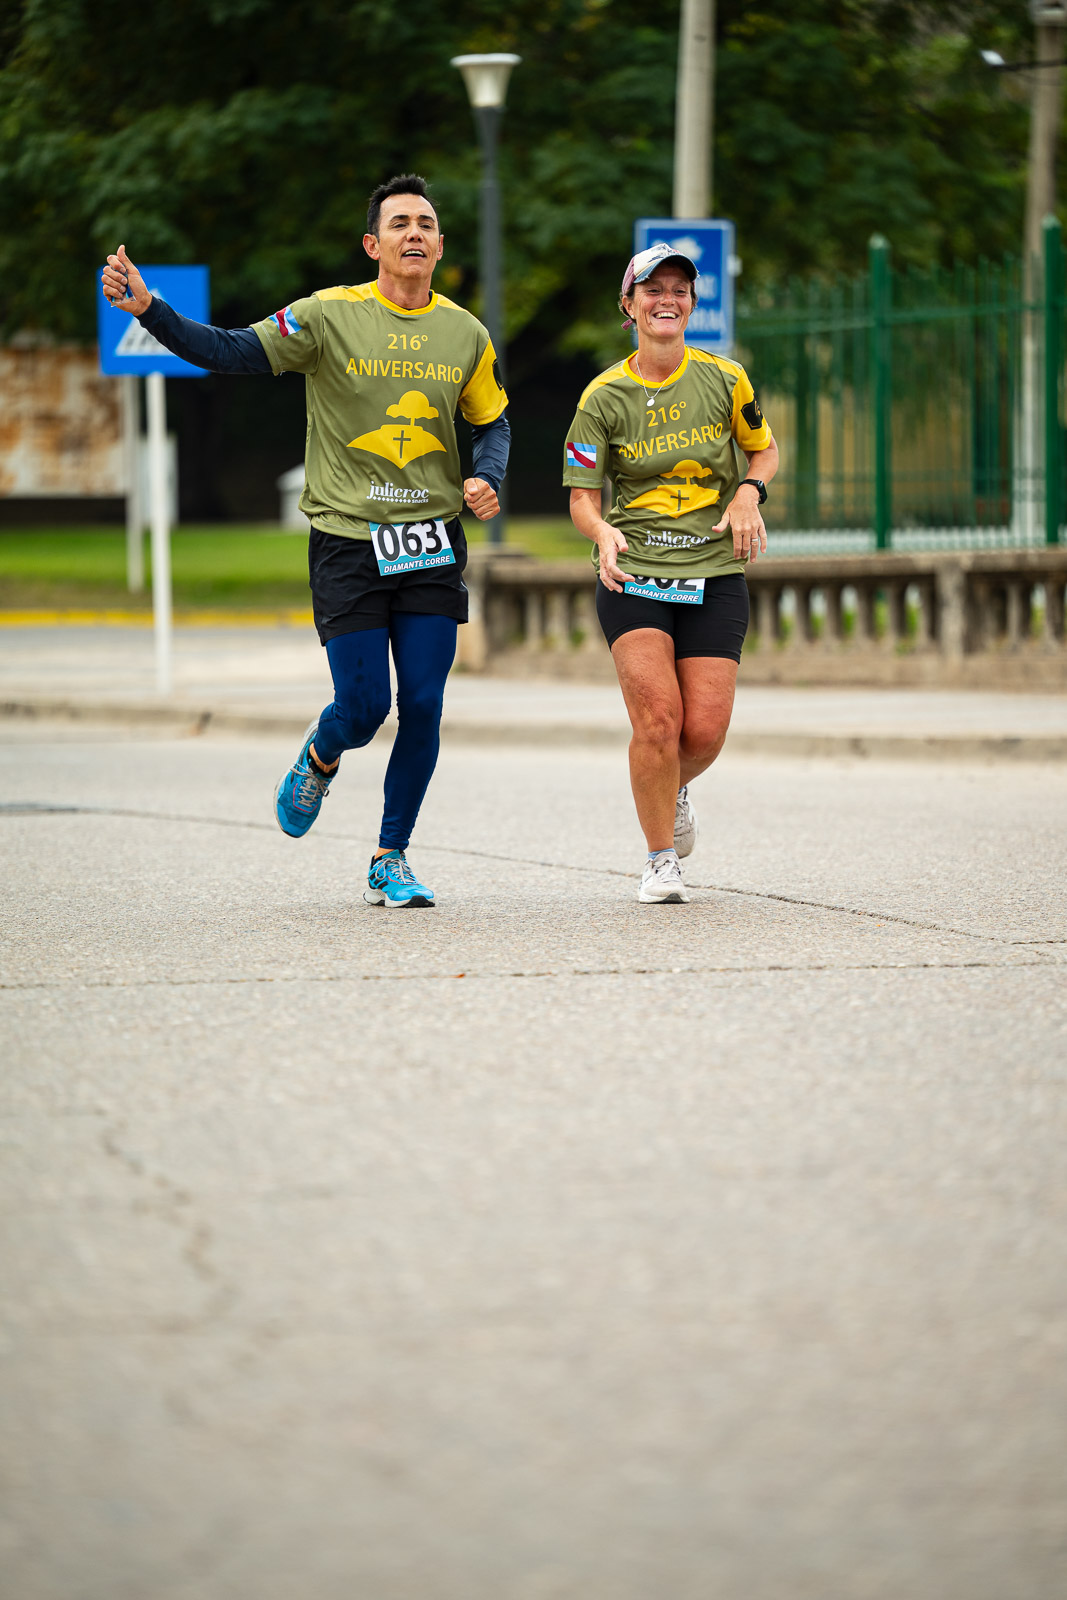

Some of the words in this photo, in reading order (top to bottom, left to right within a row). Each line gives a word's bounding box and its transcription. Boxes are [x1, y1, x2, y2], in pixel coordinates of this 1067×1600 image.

[387, 333, 428, 351] 216°
[345, 357, 463, 384] ANIVERSARIO
[646, 401, 687, 428] 216°
[366, 480, 429, 499] julicroc
[377, 518, 443, 562] 063
[383, 561, 424, 574] DIAMANTE
[425, 555, 451, 566] CORRE
[628, 586, 670, 600] DIAMANTE
[670, 592, 700, 602] CORRE
